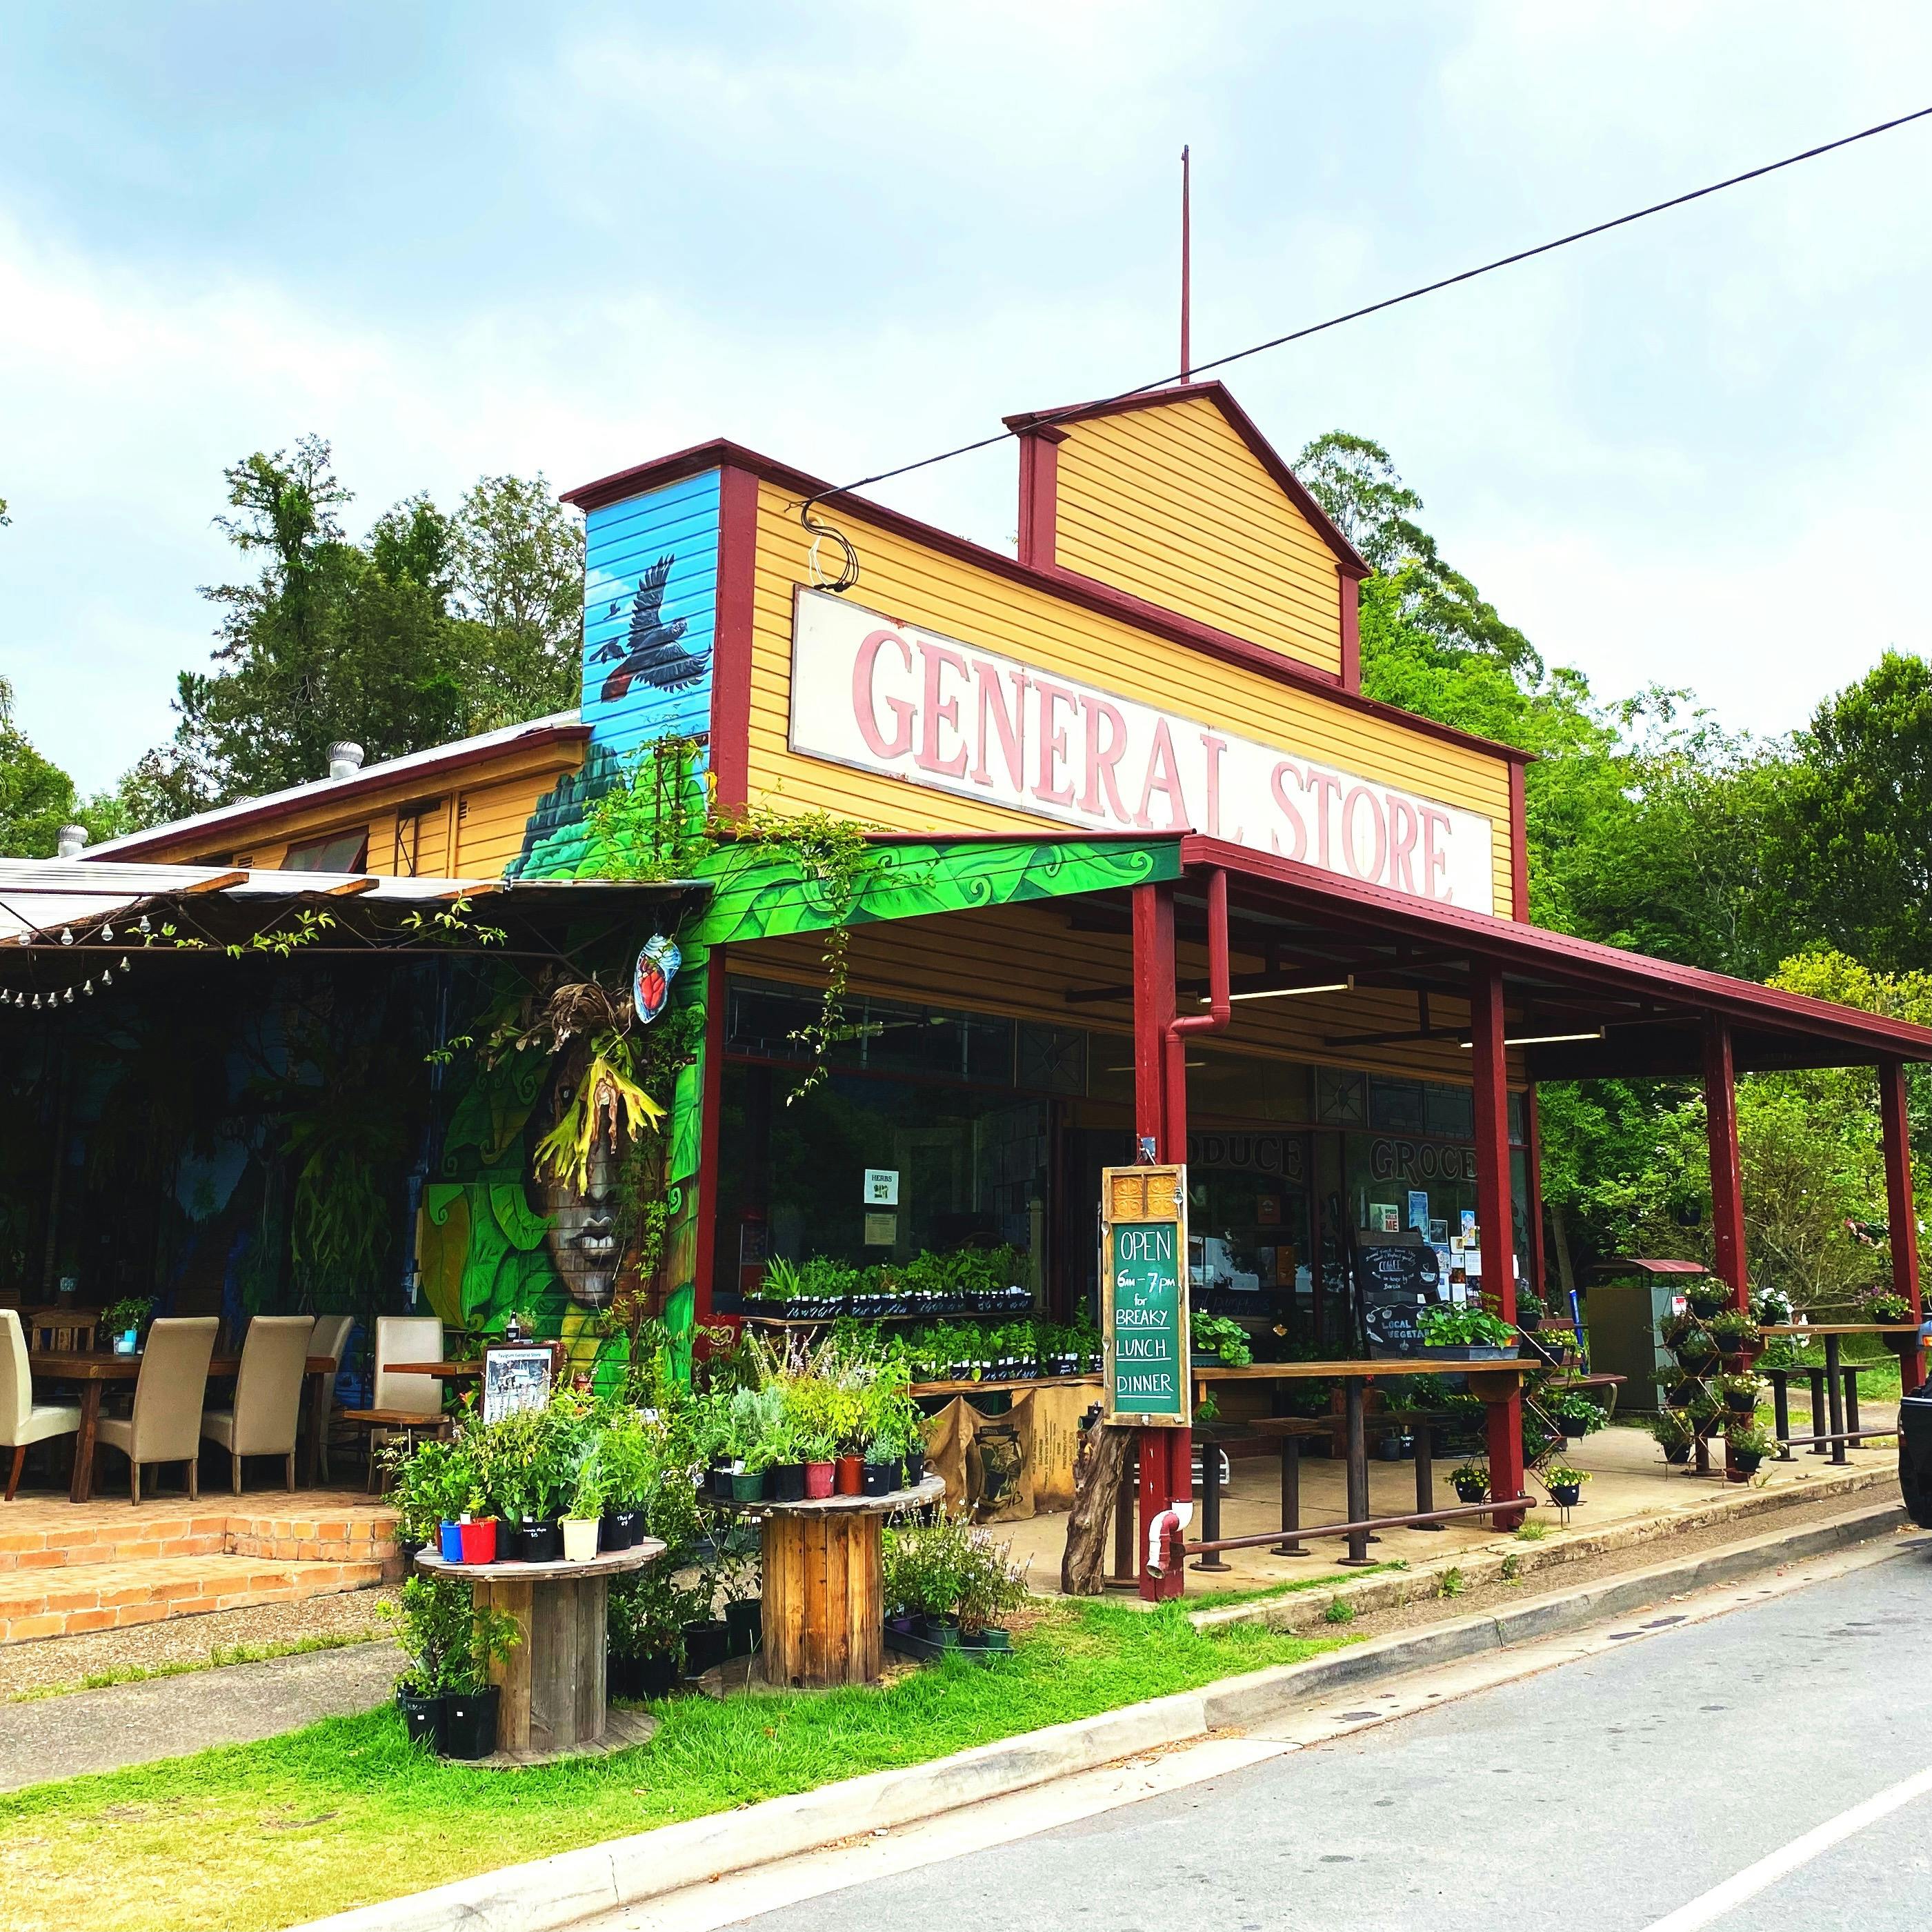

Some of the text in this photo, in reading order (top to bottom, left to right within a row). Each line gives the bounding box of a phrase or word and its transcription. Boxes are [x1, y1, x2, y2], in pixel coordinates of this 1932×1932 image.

[852, 628, 1453, 904] GENERAL STORE
[871, 1174, 893, 1182] HERBS
[1385, 1219, 1398, 1231] ME
[1120, 1230, 1171, 1262] OPEN
[1133, 1293, 1148, 1306] for
[1115, 1309, 1168, 1326] BREAKY
[1382, 1319, 1412, 1329] LOCAL
[1115, 1338, 1166, 1357] LUNCH
[1117, 1373, 1174, 1393] DINNER
